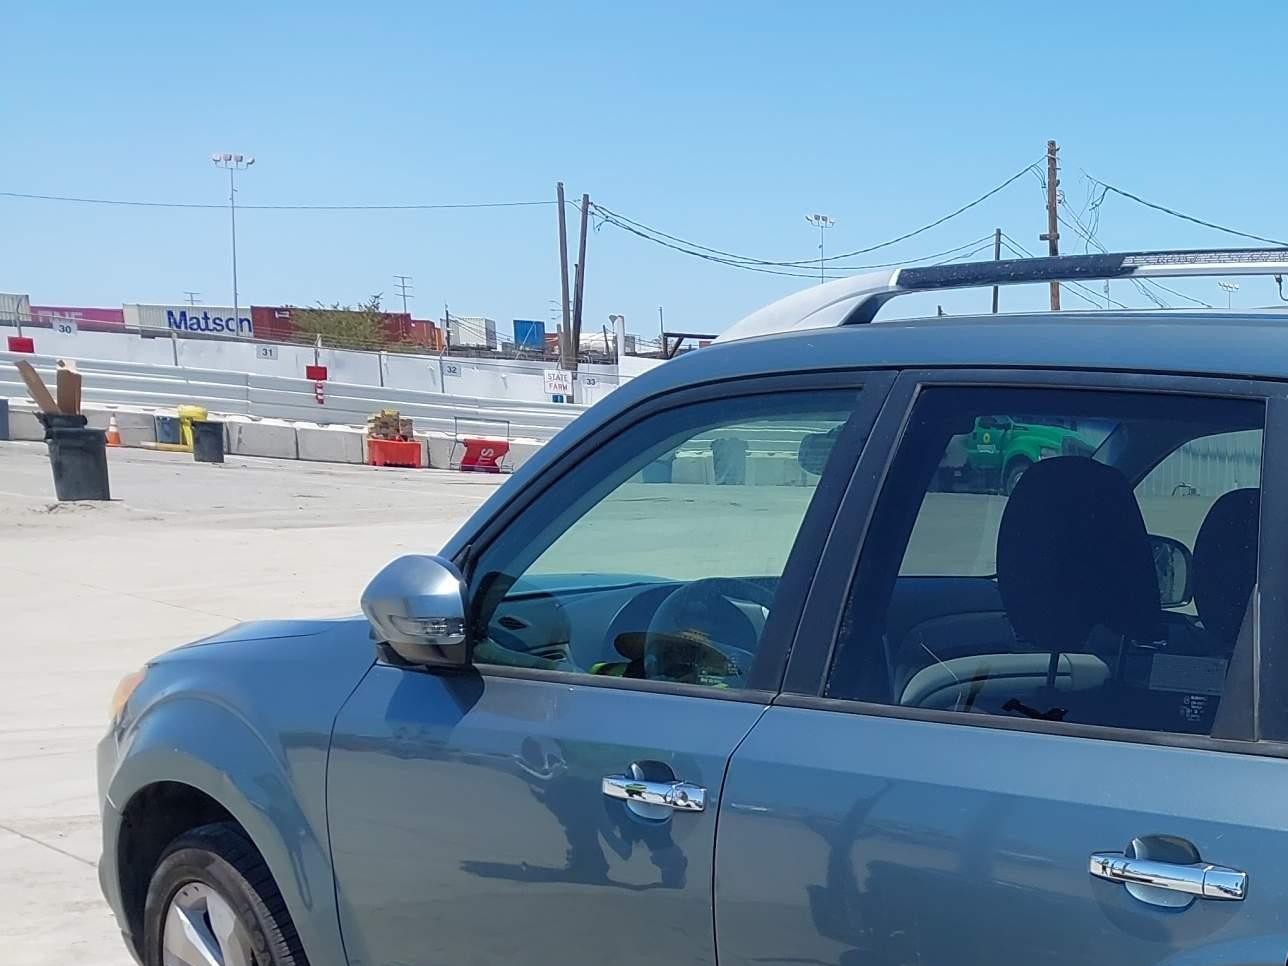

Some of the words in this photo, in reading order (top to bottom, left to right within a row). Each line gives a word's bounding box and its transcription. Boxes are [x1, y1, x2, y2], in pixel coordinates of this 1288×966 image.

[58, 324, 72, 335] 30
[261, 347, 274, 357] 31
[447, 366, 457, 374] 32
[548, 374, 568, 382] STATE
[587, 378, 596, 386] 33
[549, 383, 568, 392] FARM
